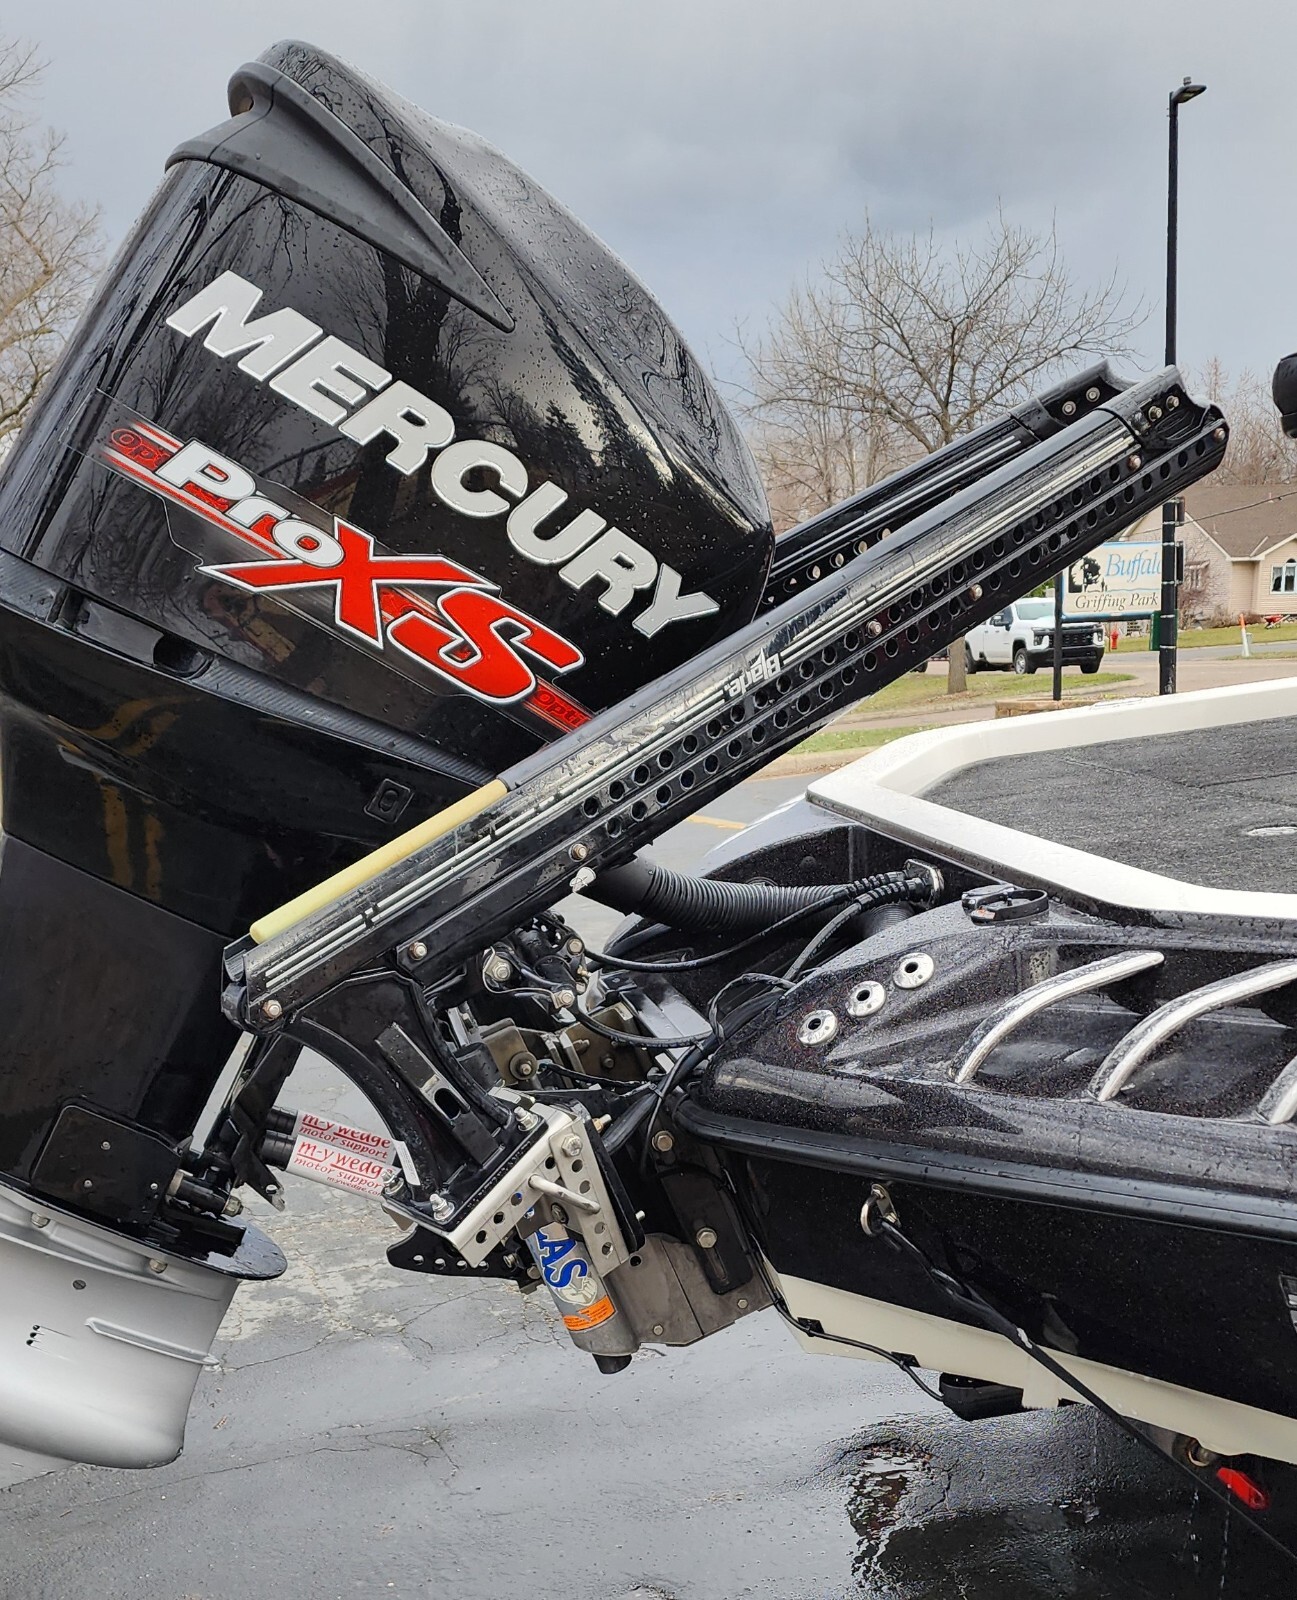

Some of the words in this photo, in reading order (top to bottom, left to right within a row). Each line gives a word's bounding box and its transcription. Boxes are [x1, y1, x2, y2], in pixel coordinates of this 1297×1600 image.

[166, 269, 720, 639] MERCURY
[1075, 593, 1125, 612] Griffing
[1130, 592, 1158, 607] Park
[728, 647, 781, 697] Blade
[297, 1141, 334, 1162] m-y
[299, 1126, 338, 1142] motor
[340, 1137, 388, 1159] support
[335, 1124, 391, 1149] wedge
[294, 1157, 335, 1174] motor
[337, 1170, 383, 1190] suppor
